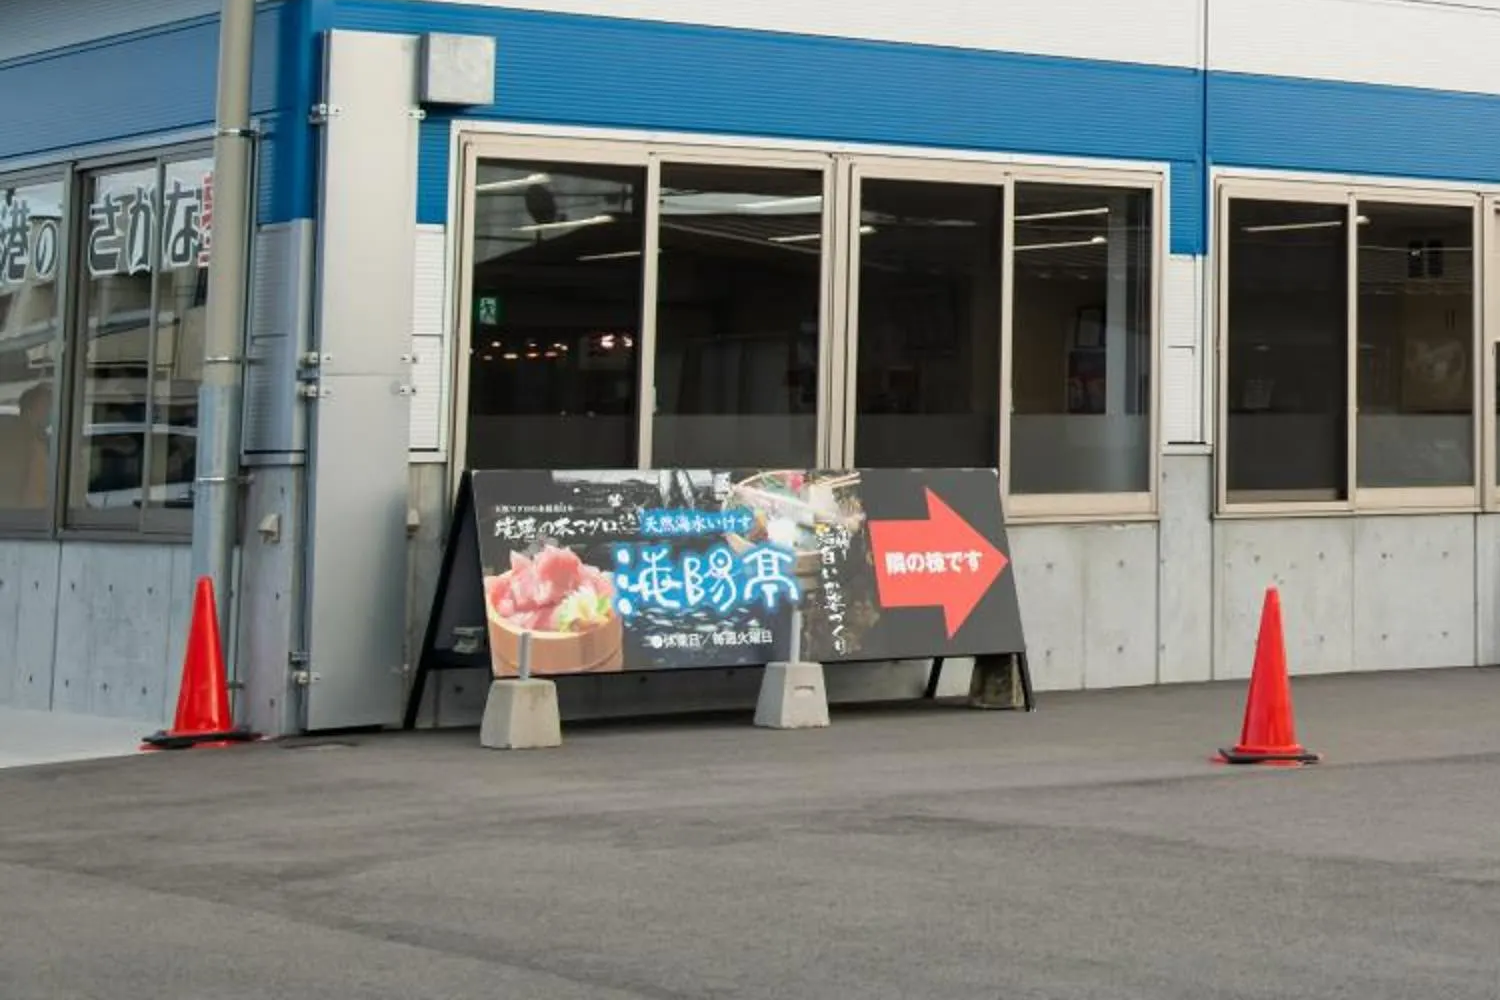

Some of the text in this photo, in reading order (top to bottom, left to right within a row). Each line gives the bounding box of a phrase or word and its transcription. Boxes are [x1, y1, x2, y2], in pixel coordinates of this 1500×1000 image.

[645, 514, 752, 534] 天然海水いけす
[616, 545, 799, 613] 海陽亭
